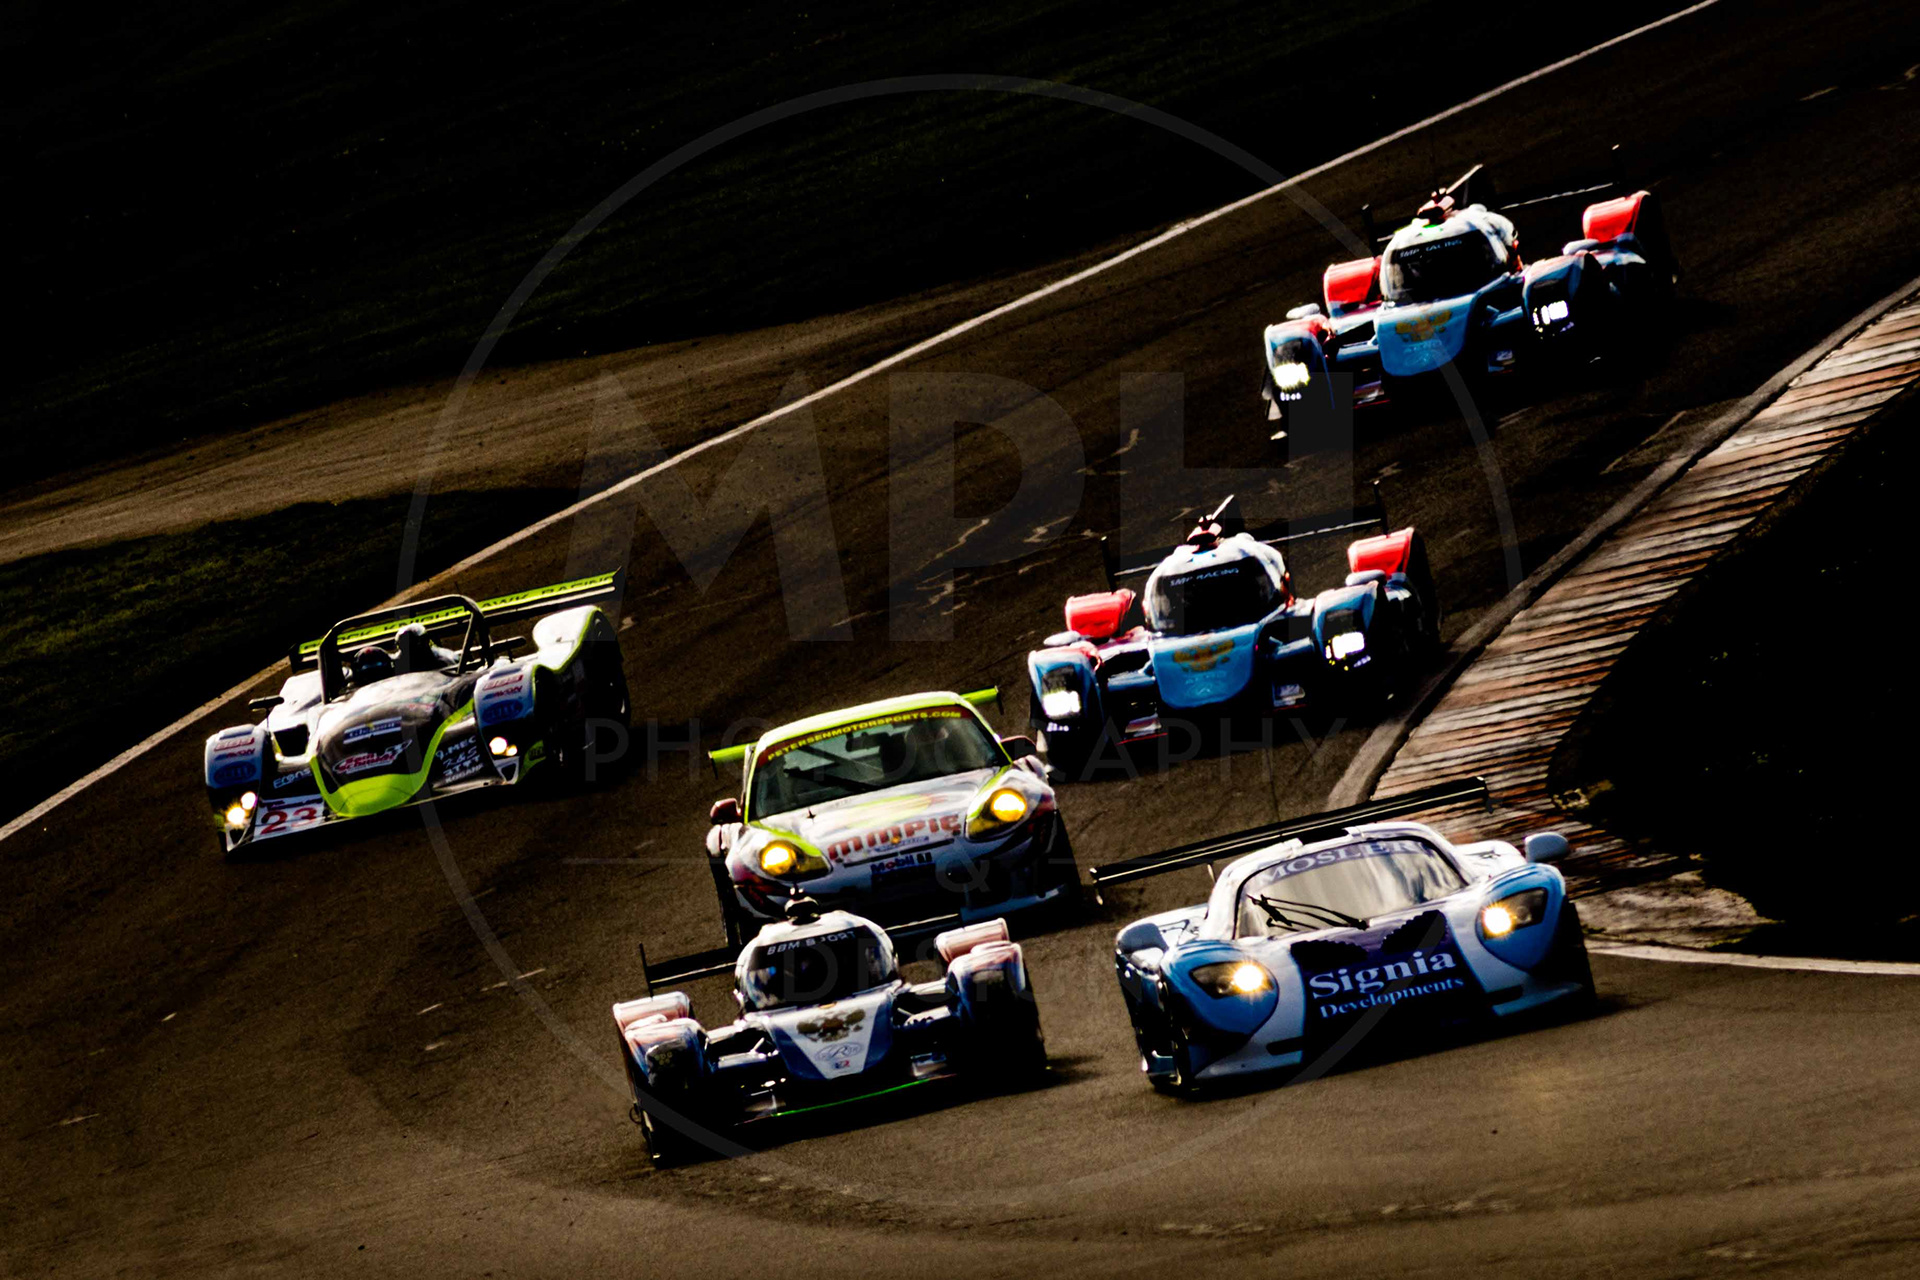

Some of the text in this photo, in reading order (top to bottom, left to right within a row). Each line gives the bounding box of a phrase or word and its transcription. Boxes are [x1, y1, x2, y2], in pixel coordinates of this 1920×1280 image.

[767, 711, 962, 762] PETERSENMOTORSPORTS.COM
[260, 807, 317, 836] 23
[870, 854, 915, 873] Mobil
[1257, 840, 1419, 885] MOSLER
[766, 940, 801, 956] BBM
[1309, 951, 1457, 1000] Signia
[1319, 978, 1466, 1019] Developments
